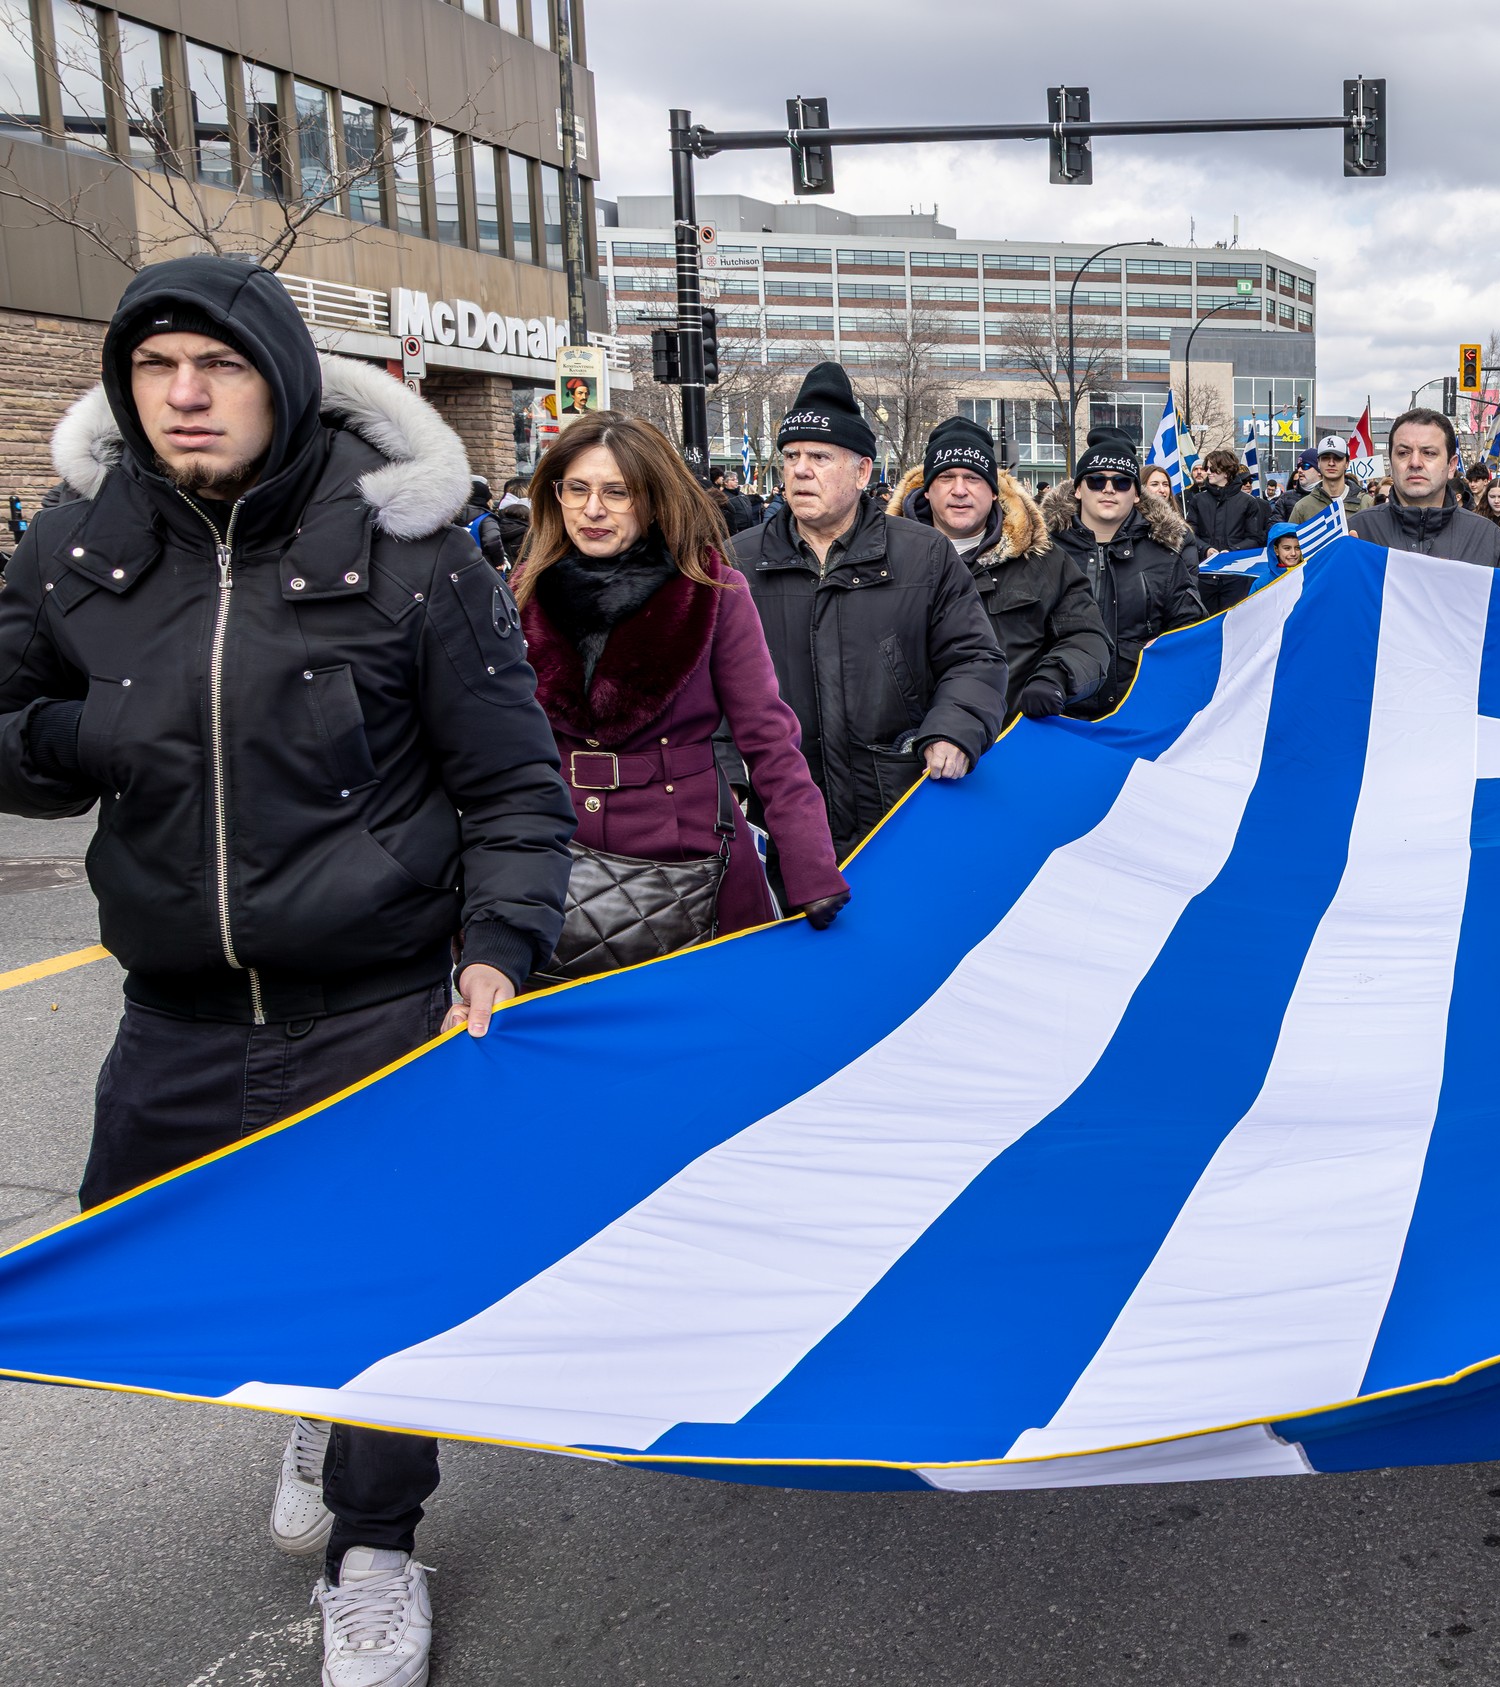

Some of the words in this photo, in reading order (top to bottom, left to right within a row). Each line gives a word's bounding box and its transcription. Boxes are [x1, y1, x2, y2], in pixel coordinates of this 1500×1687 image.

[720, 257, 760, 266] Hutchison
[1239, 283, 1251, 291] TD
[1242, 415, 1300, 436] maxi
